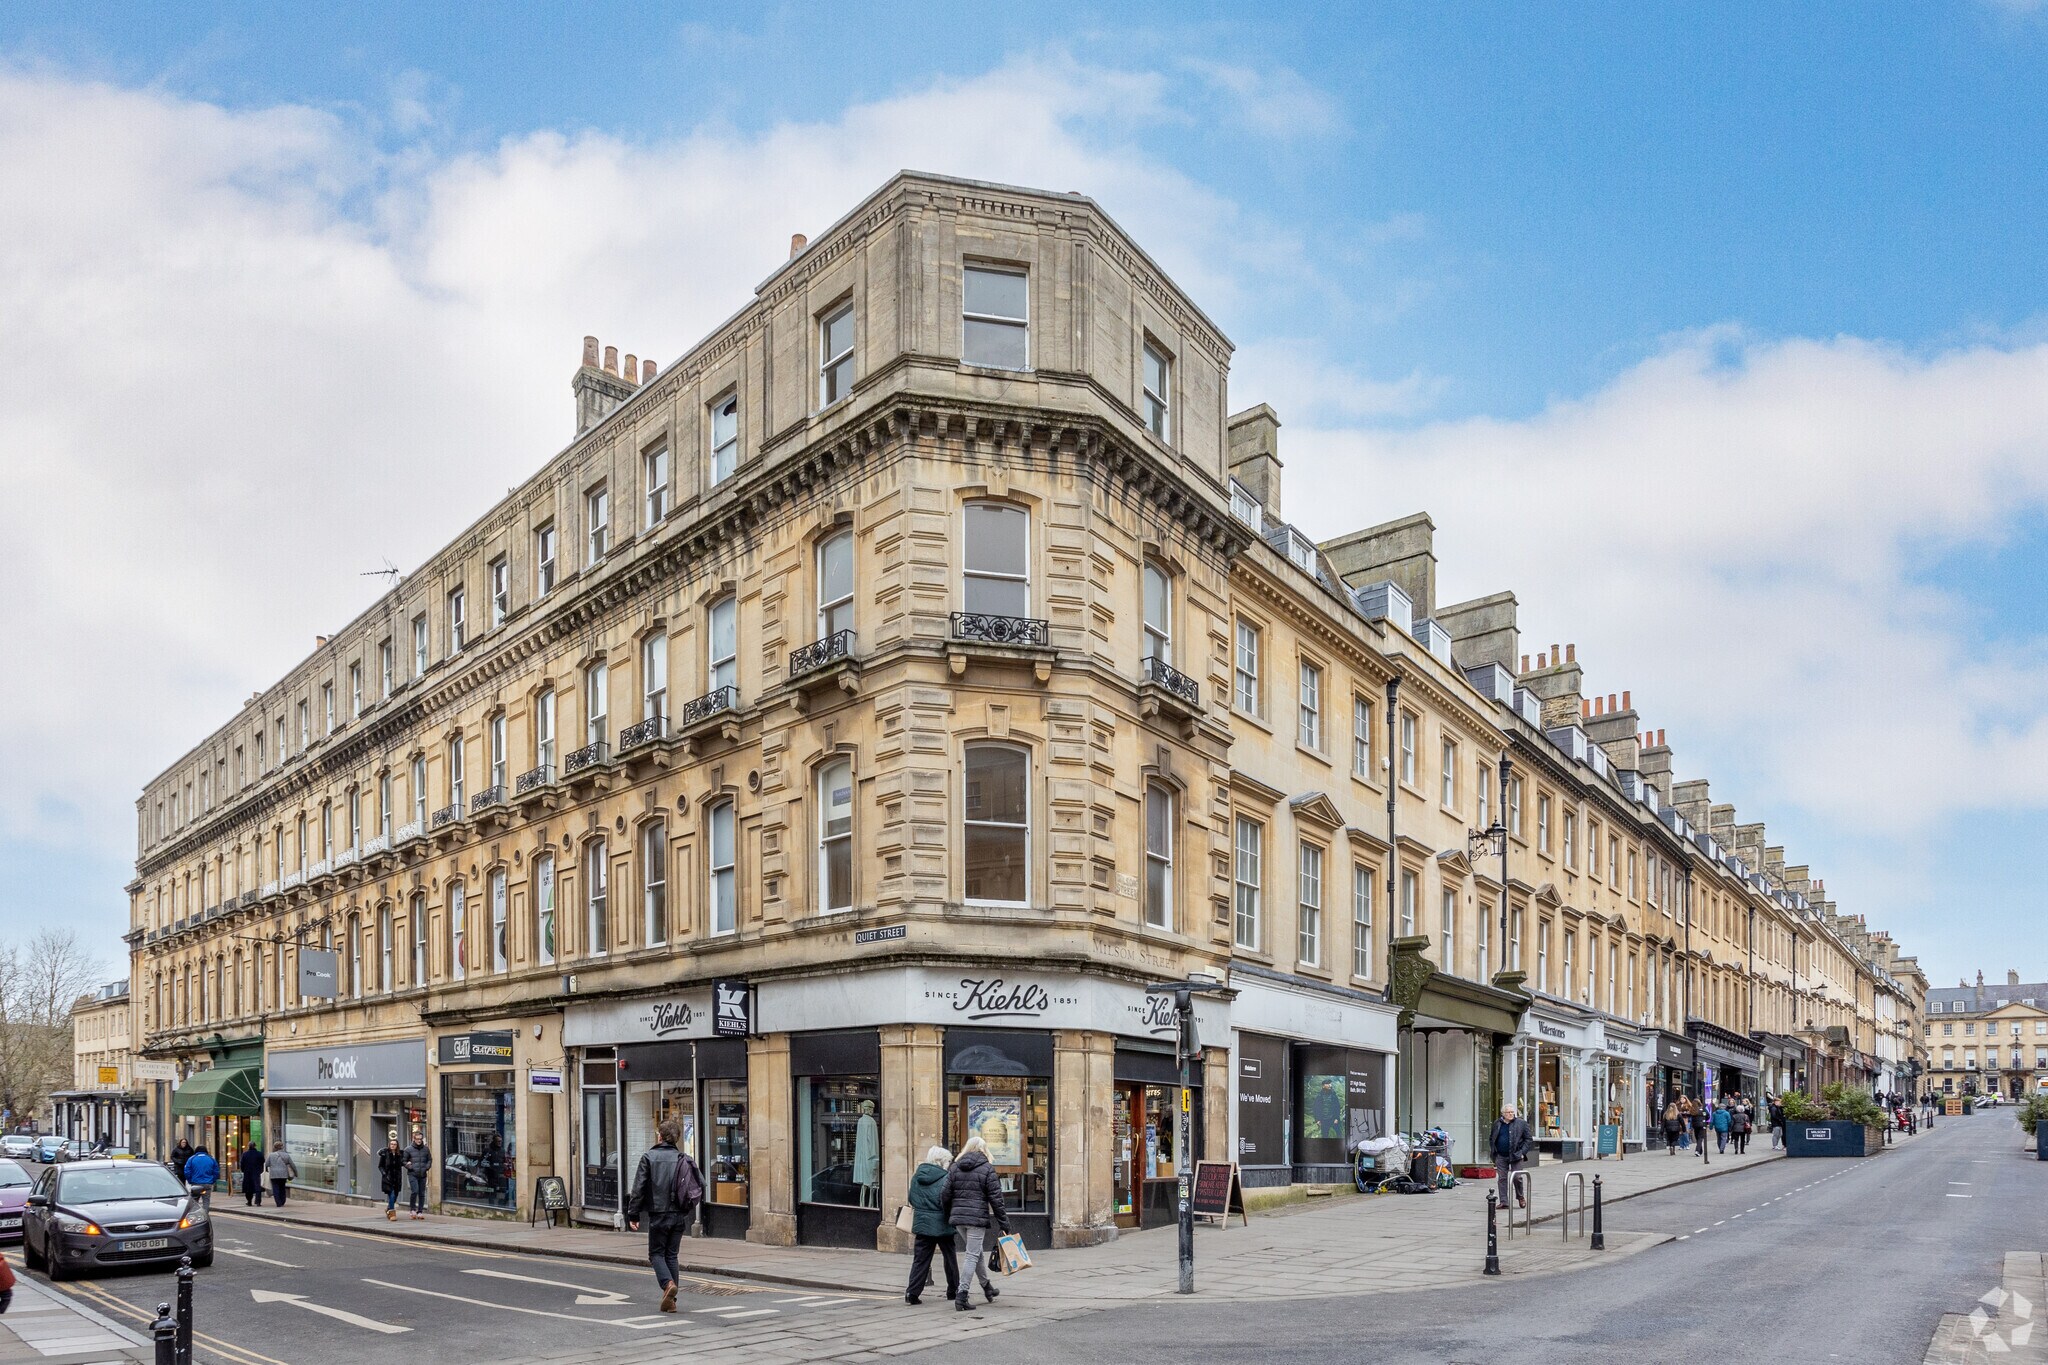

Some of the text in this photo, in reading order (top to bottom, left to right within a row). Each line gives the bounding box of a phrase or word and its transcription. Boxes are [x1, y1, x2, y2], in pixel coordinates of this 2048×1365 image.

[856, 927, 905, 942] QUIET STREET
[1093, 938, 1177, 970] MILSOM STREET
[306, 969, 332, 978] ProCook
[925, 978, 1078, 1011] SINCE Kiehl's 1851
[650, 1002, 692, 1031] Kiehl's
[1127, 1005, 1146, 1014] SINCE
[1142, 995, 1178, 1026] Kieh
[719, 1020, 747, 1030] KIEHL'S
[1538, 1020, 1566, 1039] Waterstones
[318, 1055, 358, 1080] ProCook
[1240, 1092, 1272, 1104] We've Moved
[125, 1240, 147, 1249] EN08
